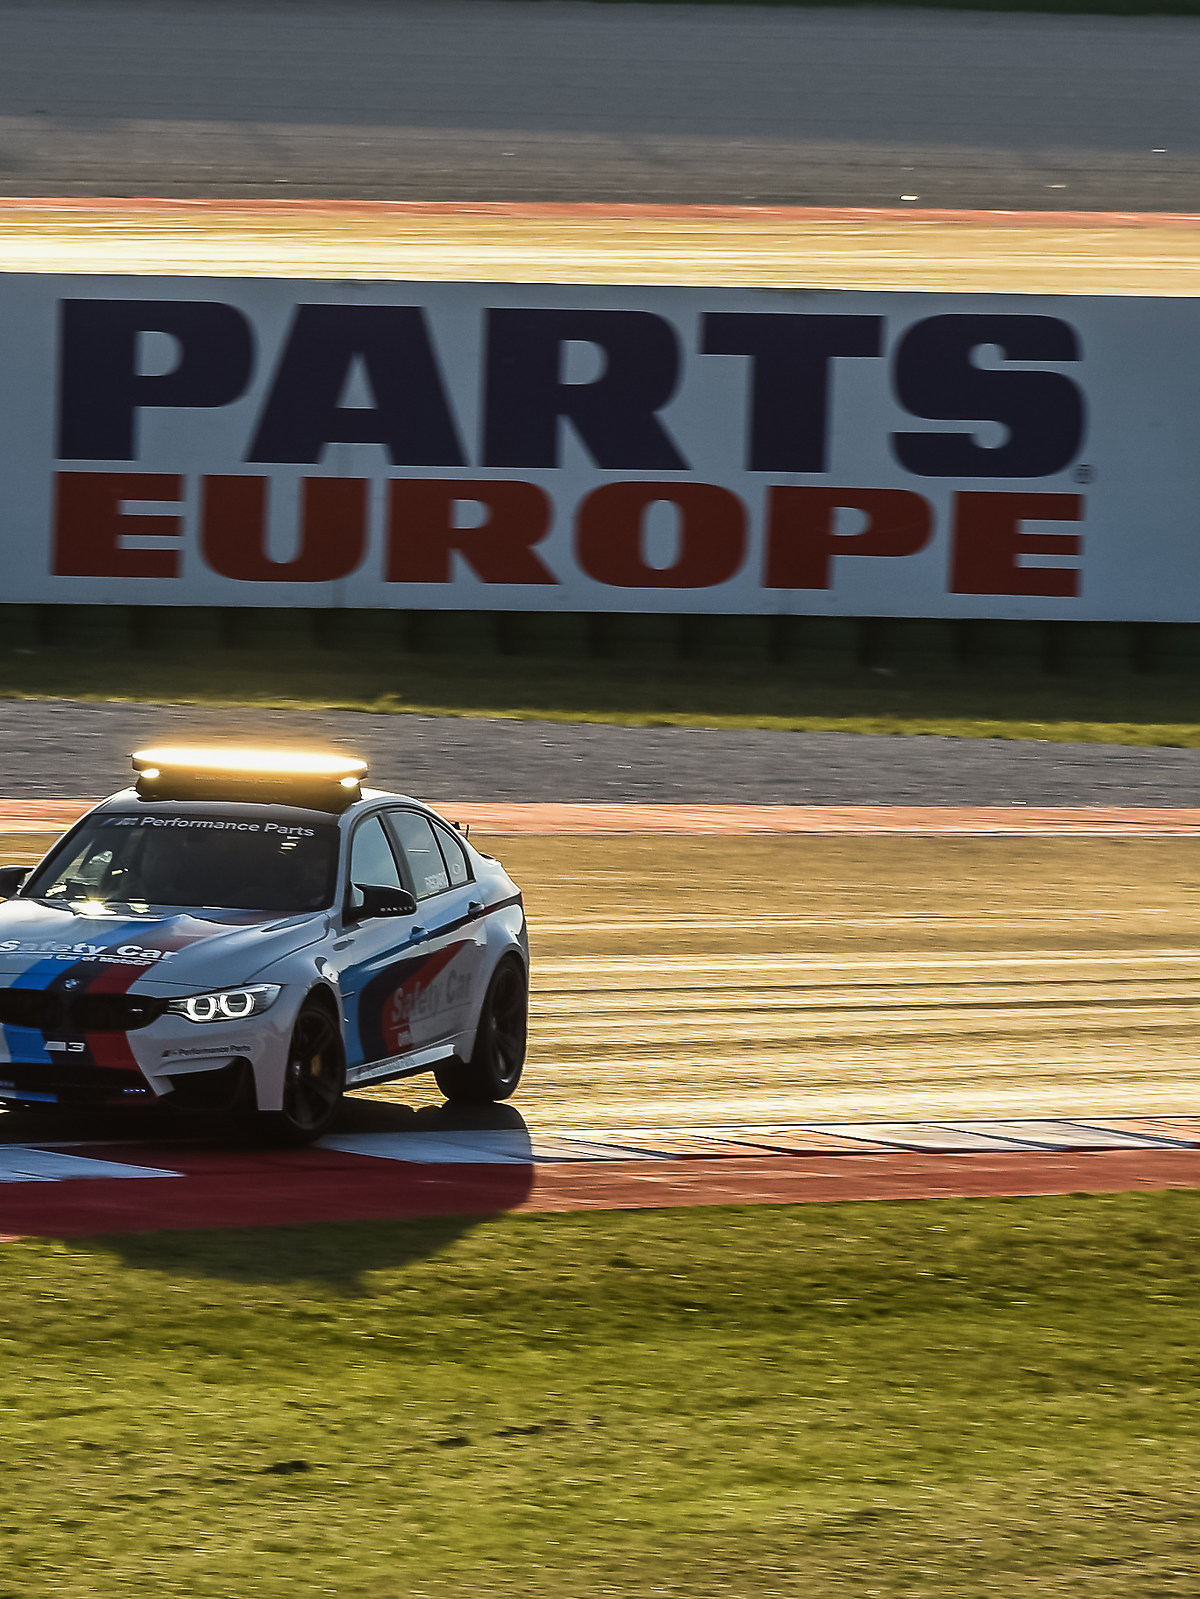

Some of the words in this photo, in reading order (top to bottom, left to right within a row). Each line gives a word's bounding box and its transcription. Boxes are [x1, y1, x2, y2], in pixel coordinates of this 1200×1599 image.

[55, 298, 1088, 479] PARTS
[51, 471, 1084, 598] EUROPE
[140, 816, 260, 832] Performance
[263, 822, 315, 836] Parts
[116, 944, 180, 961] Car
[392, 981, 442, 1023] Safety
[446, 969, 473, 1004] Car
